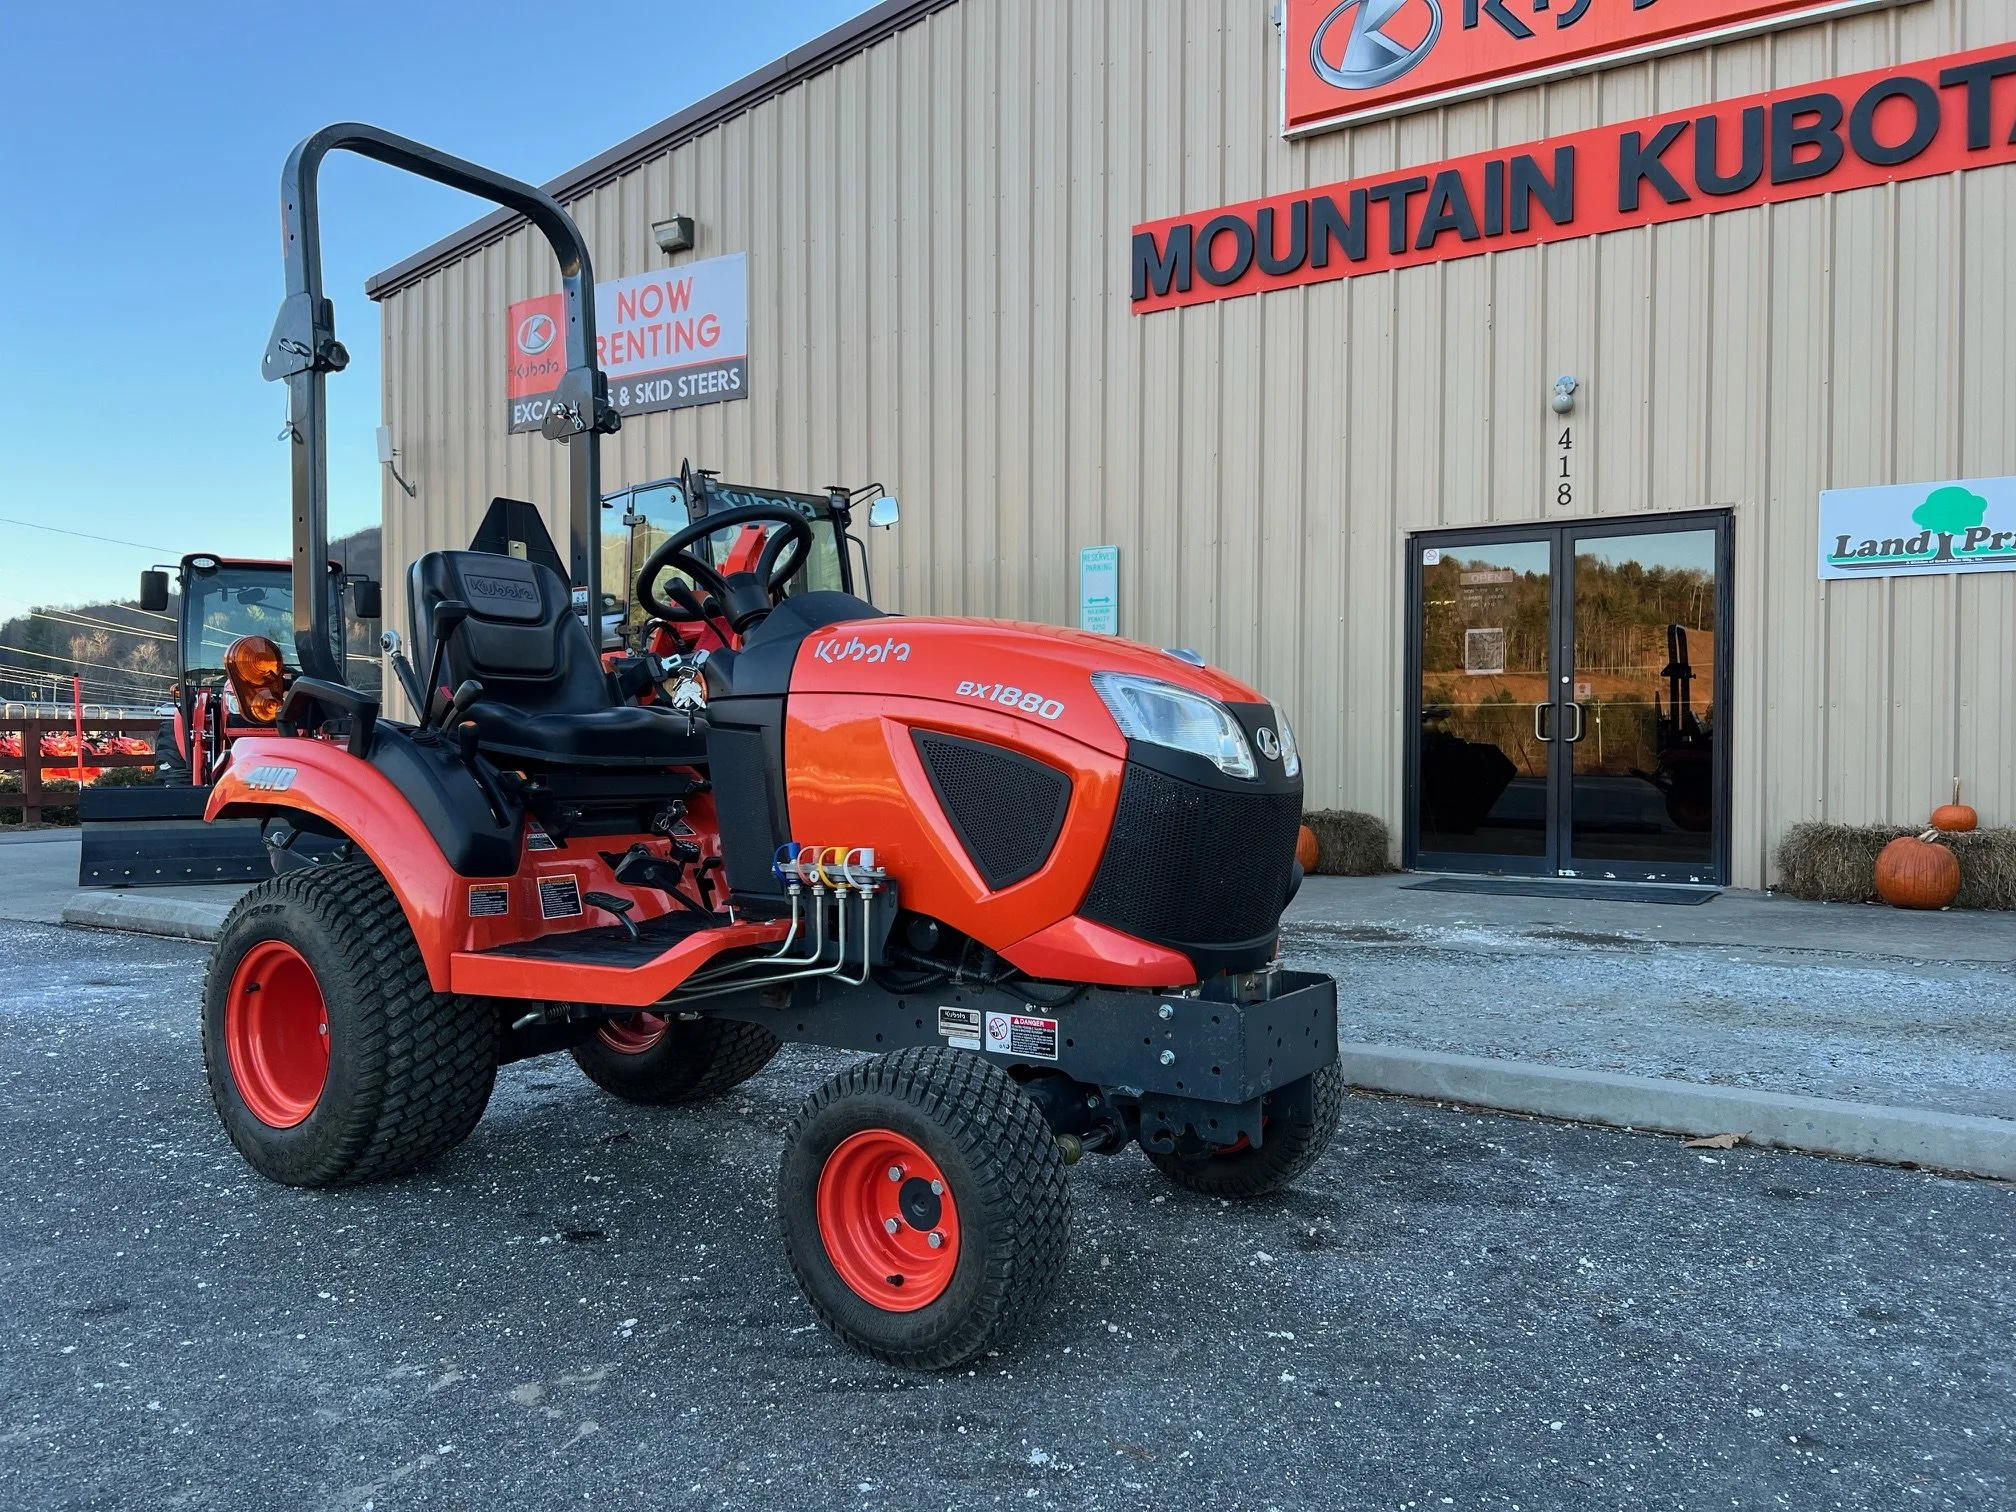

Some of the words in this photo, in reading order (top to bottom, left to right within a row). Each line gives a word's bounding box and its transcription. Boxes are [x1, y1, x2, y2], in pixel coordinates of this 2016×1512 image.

[1131, 145, 1575, 300] MOUNTAIN
[1618, 54, 2016, 215] KUBOT
[617, 275, 693, 325] NOW
[596, 313, 721, 367] RENTING
[514, 359, 559, 380] Kubota
[619, 386, 630, 407] &
[635, 380, 673, 404] SKID
[678, 368, 741, 397] STEERS
[1083, 551, 1116, 561] RESERVED
[1832, 530, 1932, 558] Land
[1085, 562, 1113, 572] PARKING
[1471, 571, 1503, 583] OPEN
[471, 578, 534, 600] Kubota
[814, 636, 912, 664] Kubota
[955, 680, 1065, 720] BX1880
[244, 766, 299, 792] 4WD
[1020, 1018, 1045, 1028] DANGER
